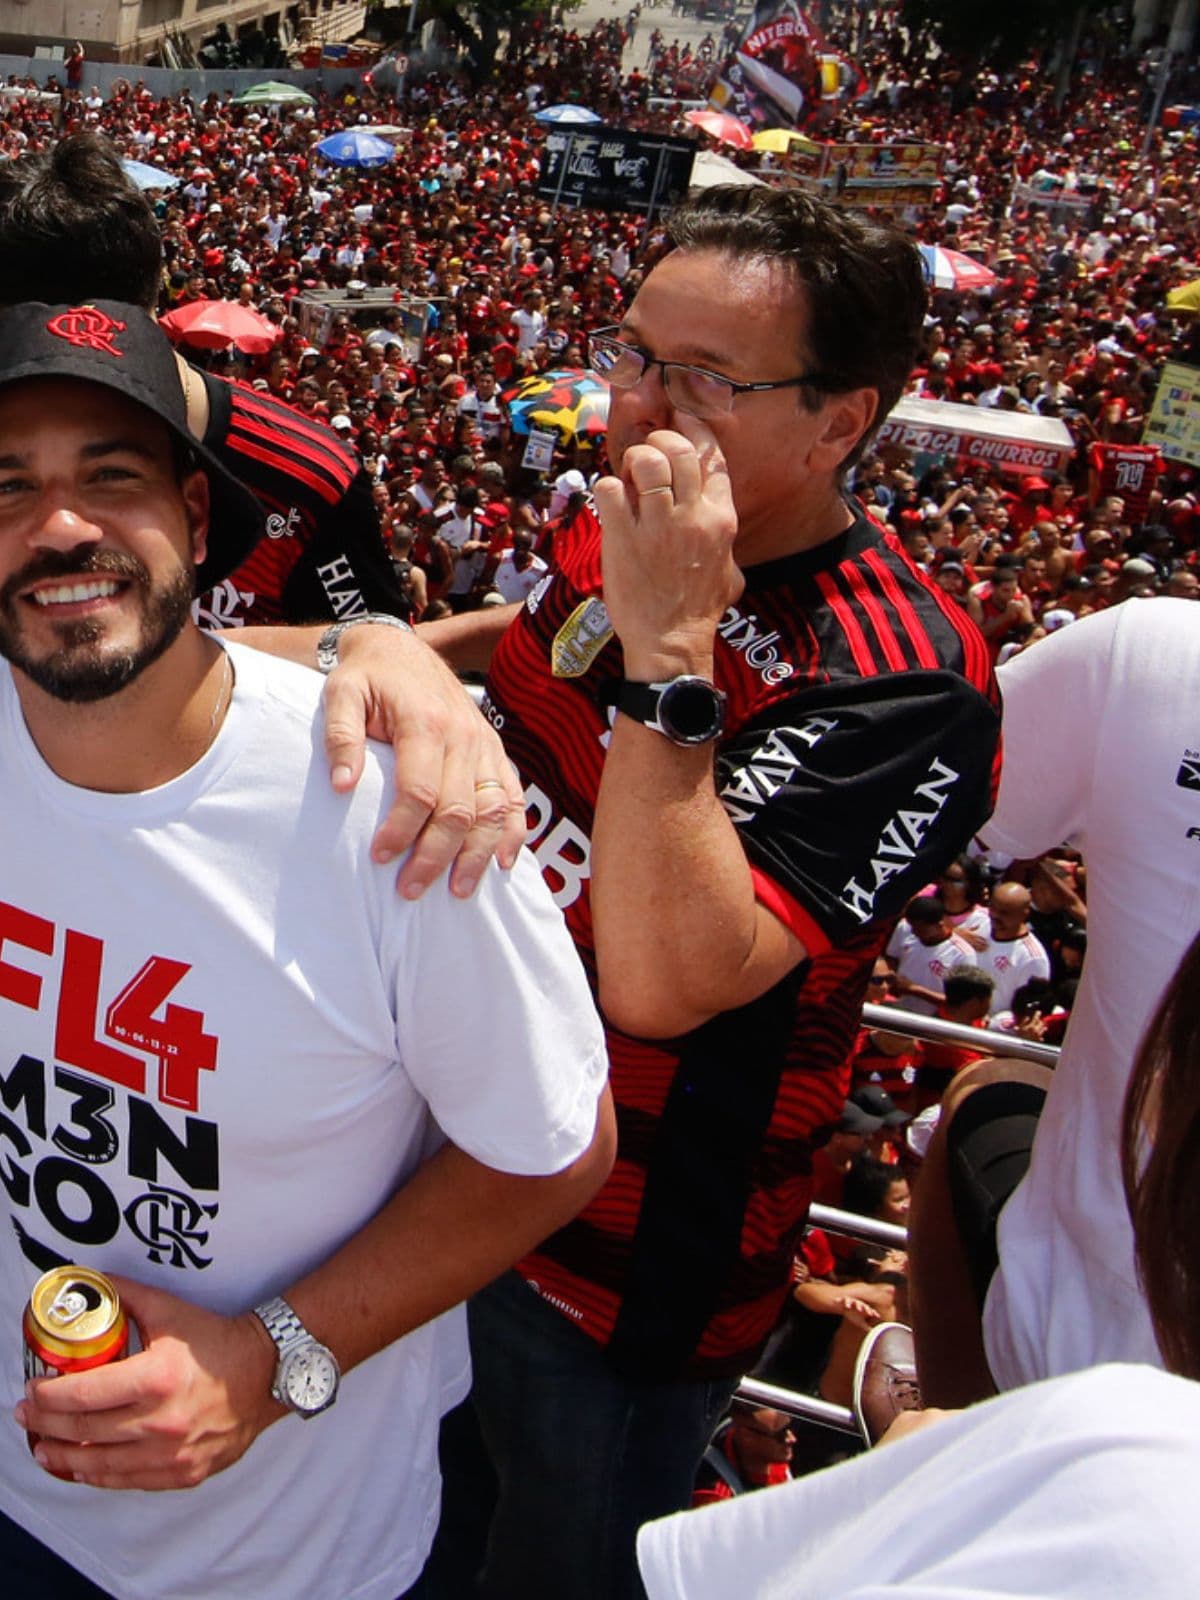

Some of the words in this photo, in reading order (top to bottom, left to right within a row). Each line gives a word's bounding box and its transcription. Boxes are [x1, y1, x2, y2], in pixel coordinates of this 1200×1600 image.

[876, 424, 960, 453] PIPOCA
[969, 440, 1058, 468] CHURROS
[316, 554, 369, 621] HAV
[717, 606, 794, 686] pixbe
[839, 756, 961, 925] HAVAN
